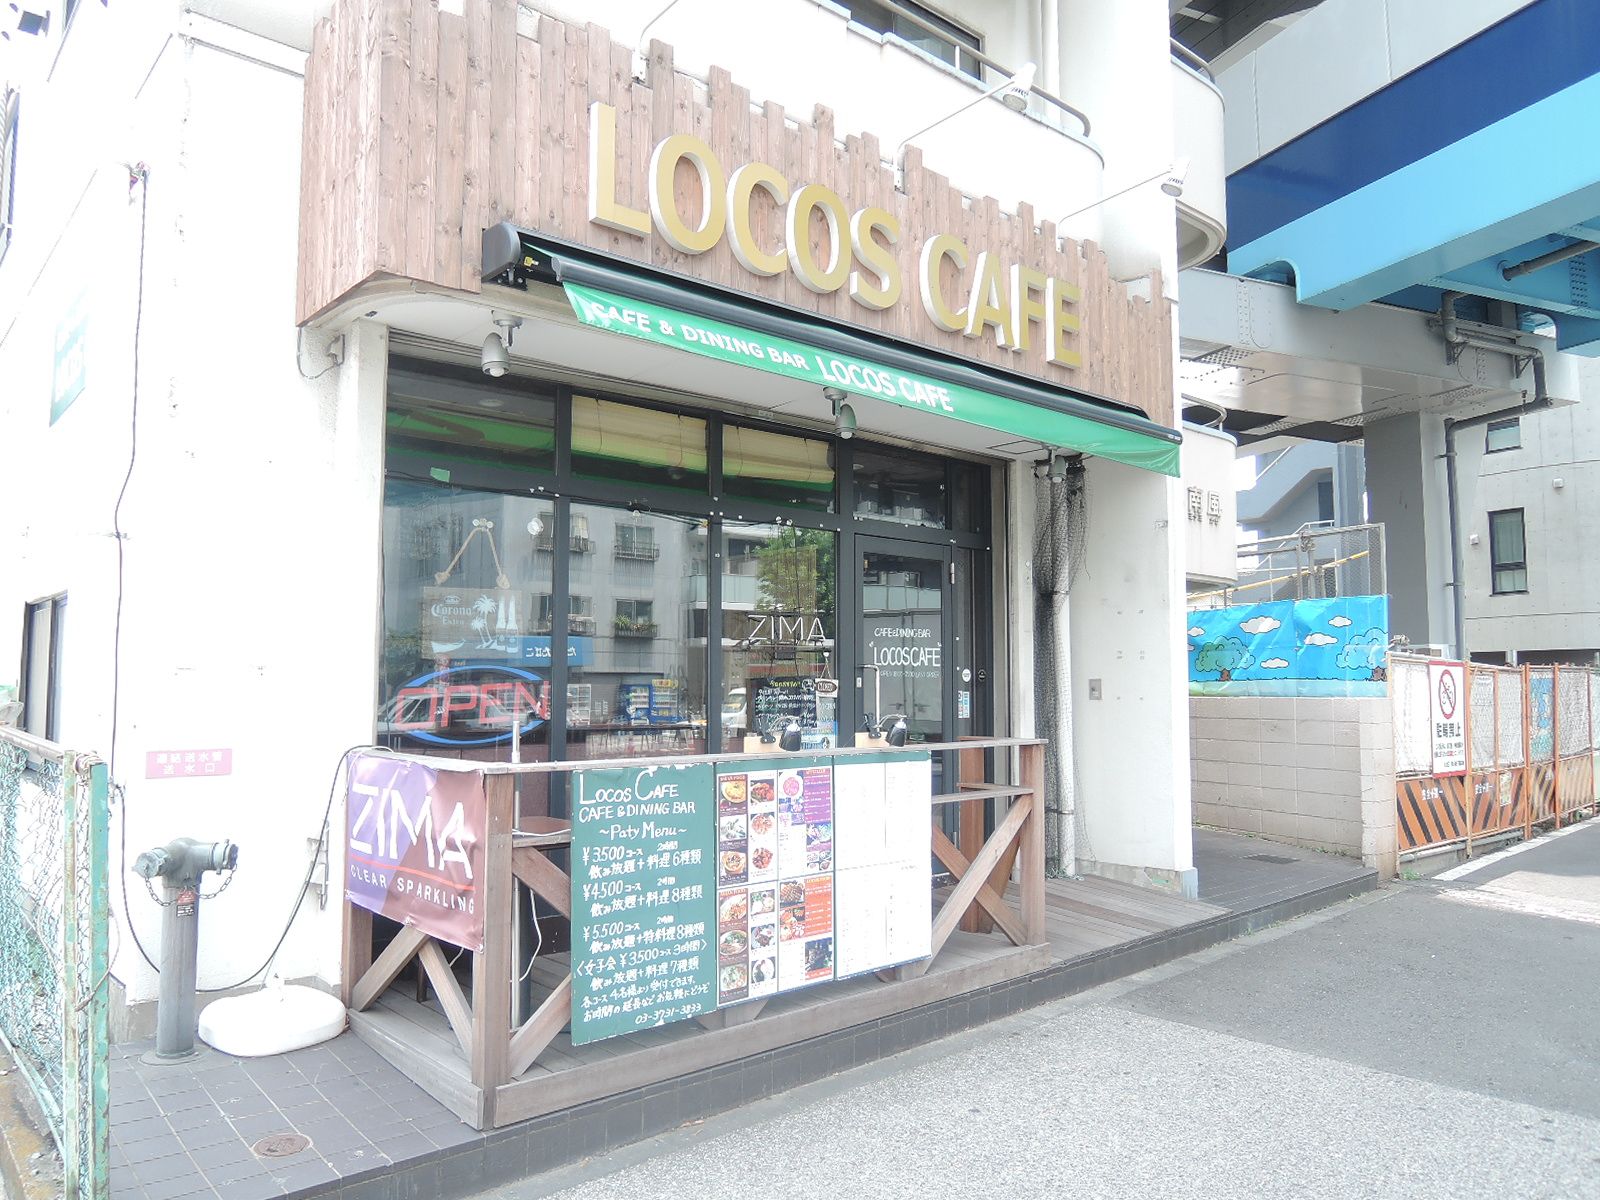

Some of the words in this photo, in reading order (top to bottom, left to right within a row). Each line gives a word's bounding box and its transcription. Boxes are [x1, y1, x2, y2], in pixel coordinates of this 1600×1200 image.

[589, 101, 901, 311] LOCOS
[919, 233, 1081, 369] CAFE
[589, 302, 651, 333] CAFE
[659, 320, 674, 336] &
[680, 323, 765, 360] DINING
[766, 346, 811, 371] BAR
[815, 355, 898, 397] LOCOS
[898, 376, 955, 413] CAFE
[431, 604, 472, 617] Corona
[748, 615, 826, 643] ZIMA
[873, 647, 910, 666] LOCOS
[910, 647, 941, 667] CAFE
[396, 680, 551, 731] OPEN
[350, 783, 474, 880] ZIMA
[579, 806, 614, 823] CAFE
[673, 801, 696, 814] BAR
[350, 864, 387, 889] CLEAR
[396, 877, 475, 914] SPARKLING
